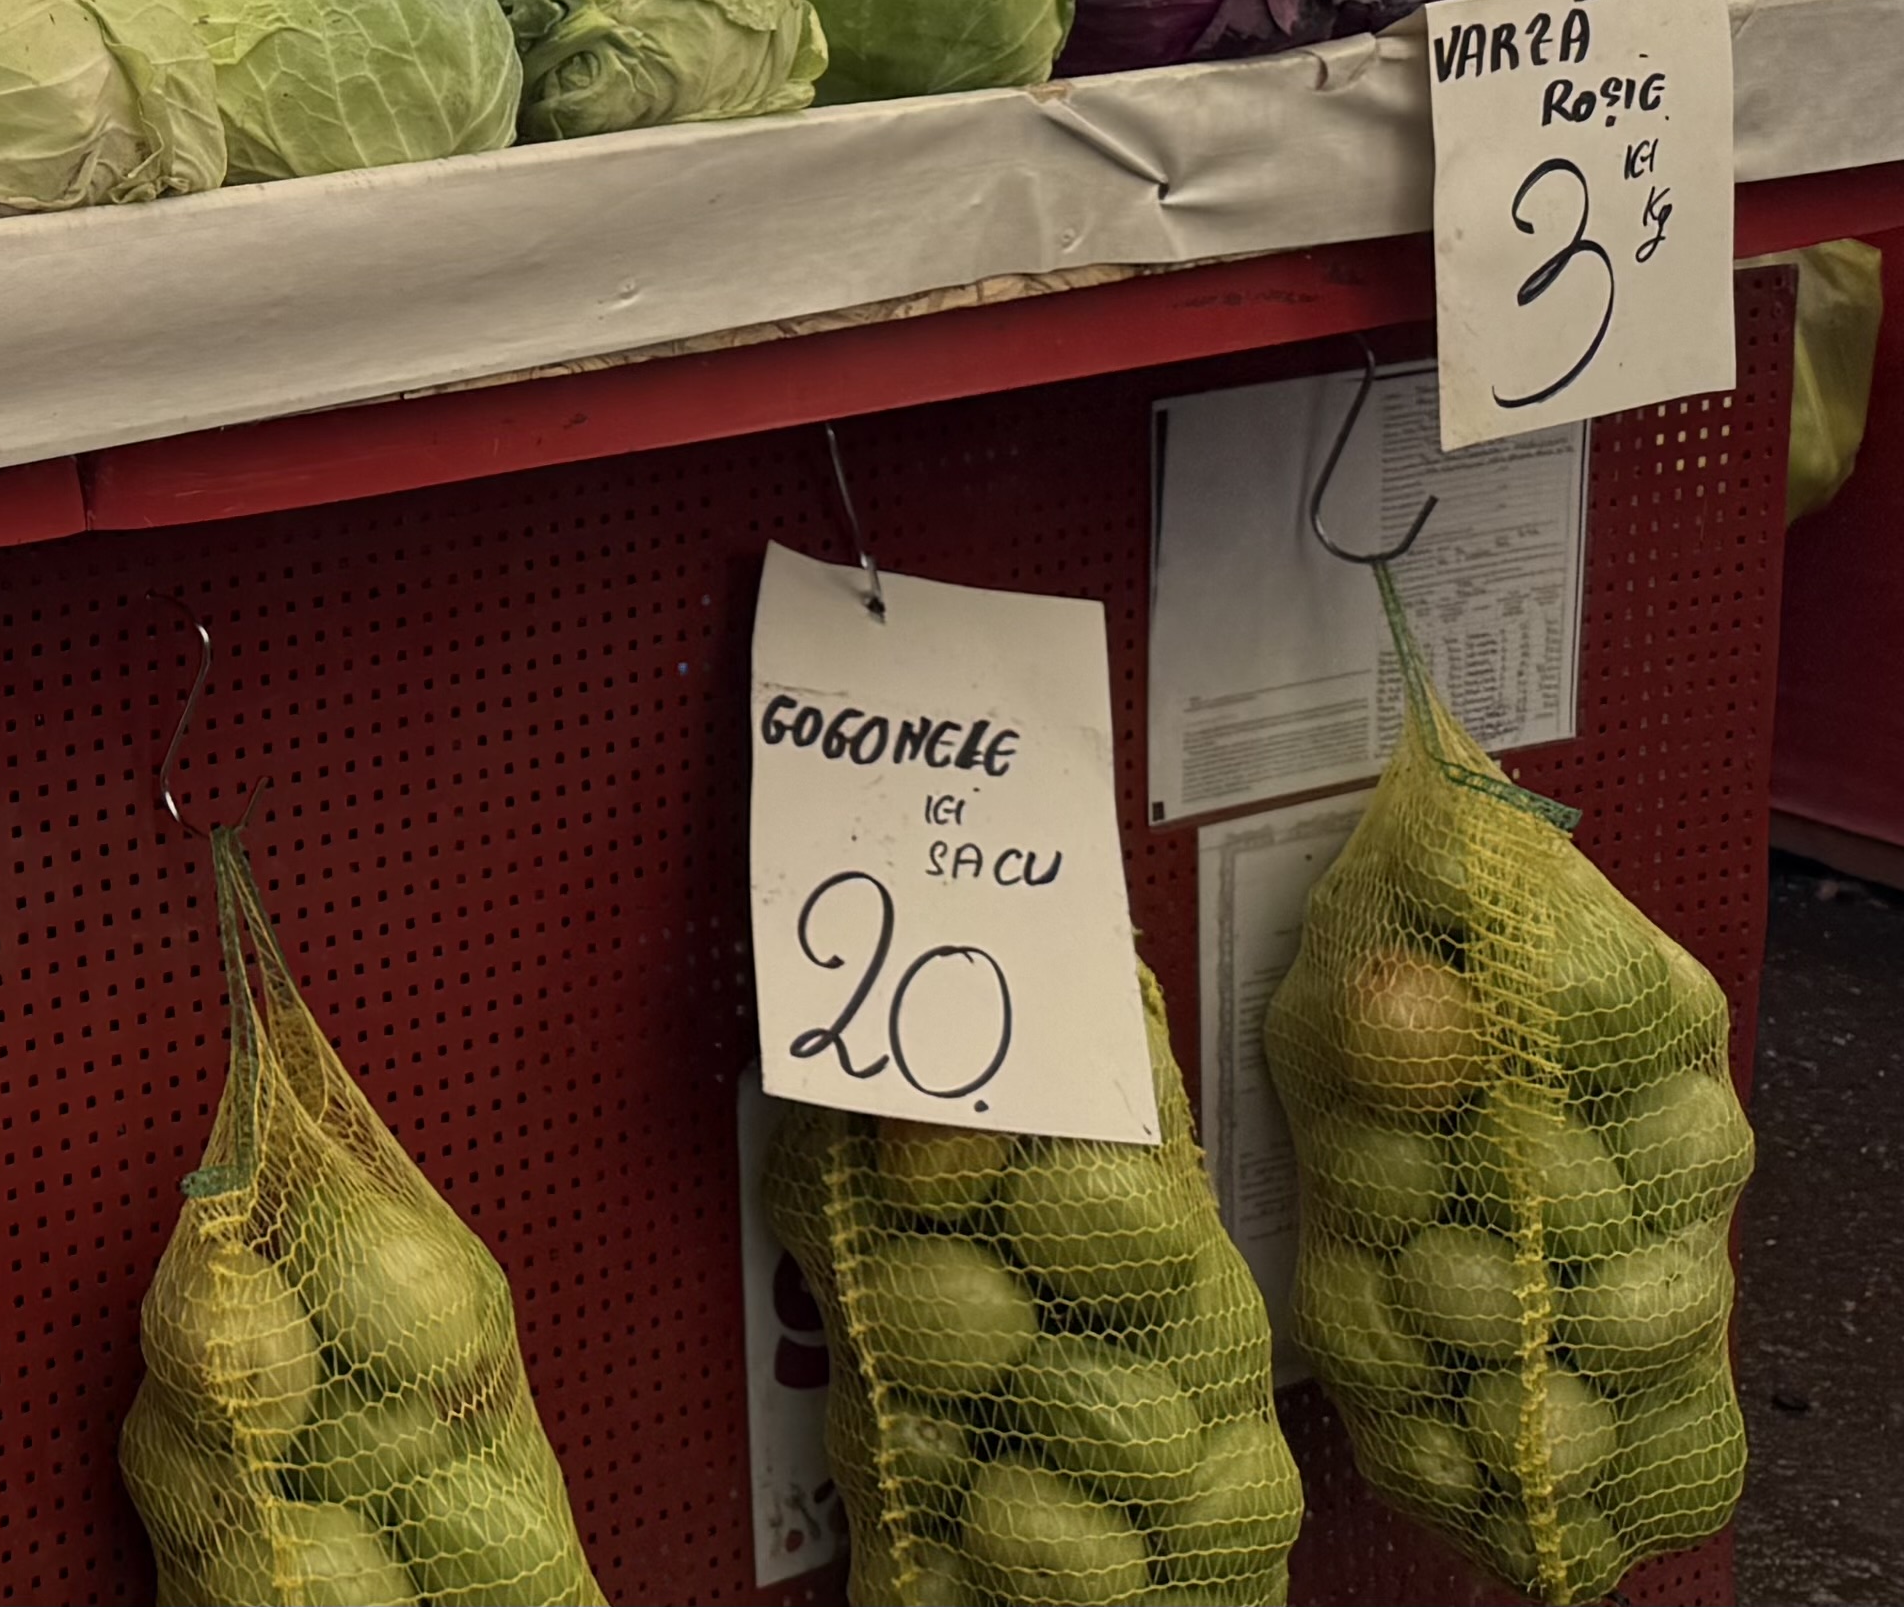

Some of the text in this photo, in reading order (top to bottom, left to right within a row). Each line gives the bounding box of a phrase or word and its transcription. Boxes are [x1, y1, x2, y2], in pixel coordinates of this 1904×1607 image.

[1492, 158, 1614, 408] 3
[762, 695, 1020, 776] GOGONELE
[926, 841, 1062, 885] SACU
